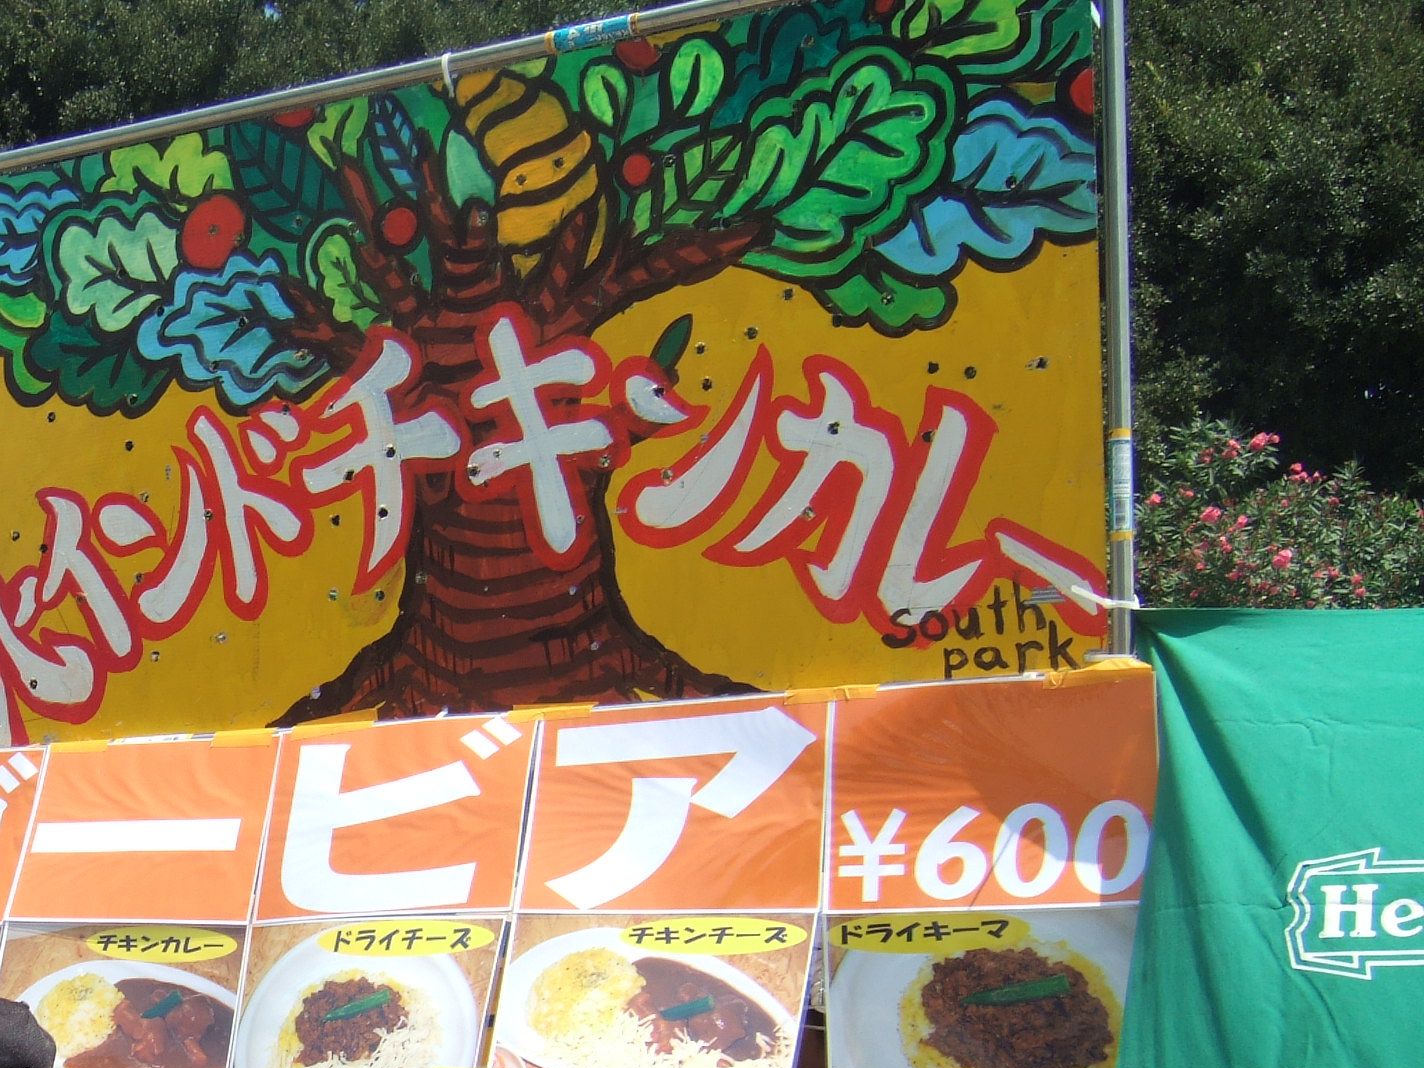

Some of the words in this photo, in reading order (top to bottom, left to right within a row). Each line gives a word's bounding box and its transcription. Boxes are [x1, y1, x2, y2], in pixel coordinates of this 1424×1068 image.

[881, 574, 1047, 648] south
[943, 620, 1080, 679] park
[837, 799, 1151, 902] ¥600
[838, 918, 1010, 943] ドライキーマ
[1318, 883, 1424, 938] He
[96, 934, 227, 956] チキンカレー
[332, 929, 472, 952] ドライチーズ
[627, 923, 789, 945] チキンチーズ
